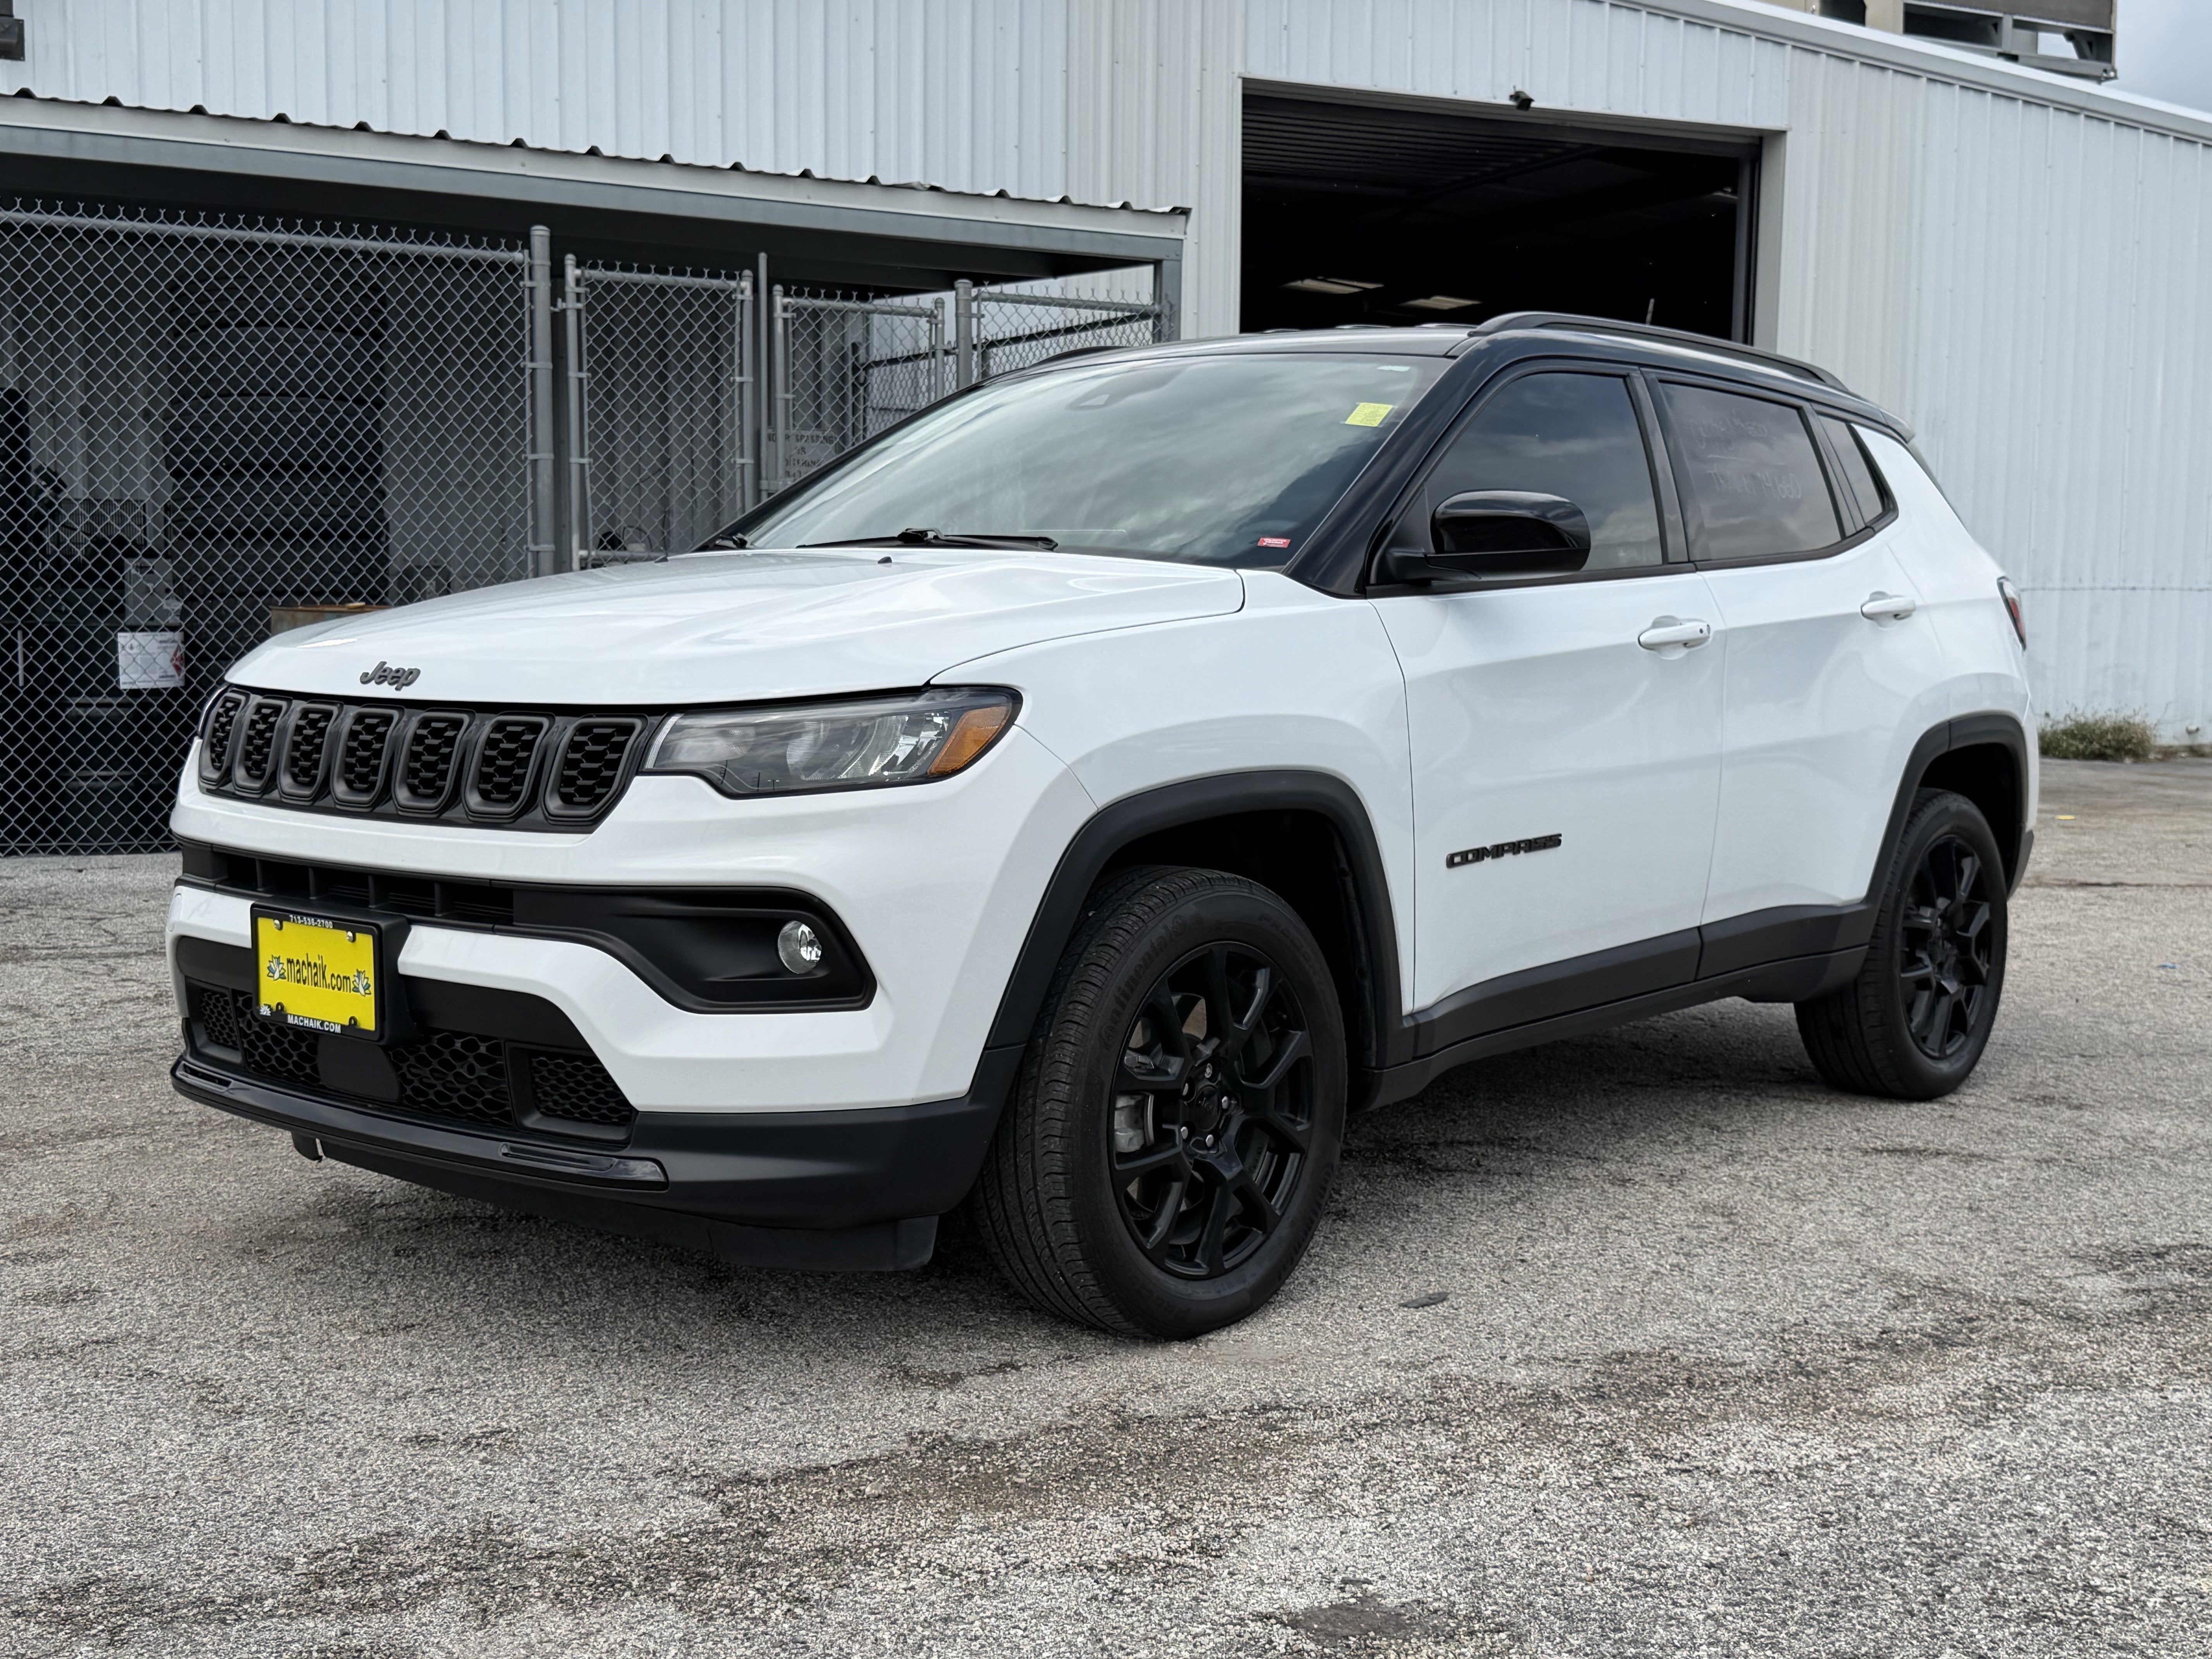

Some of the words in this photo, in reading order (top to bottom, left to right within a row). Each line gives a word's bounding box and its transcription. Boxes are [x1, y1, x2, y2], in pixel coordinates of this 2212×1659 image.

[360, 661, 421, 691] Jeep
[1446, 833, 1562, 869] COMPASS
[286, 953, 352, 993] machaik.com
[1099, 924, 1173, 1049] Continental
[287, 1015, 341, 1034] MACHAIK.COM
